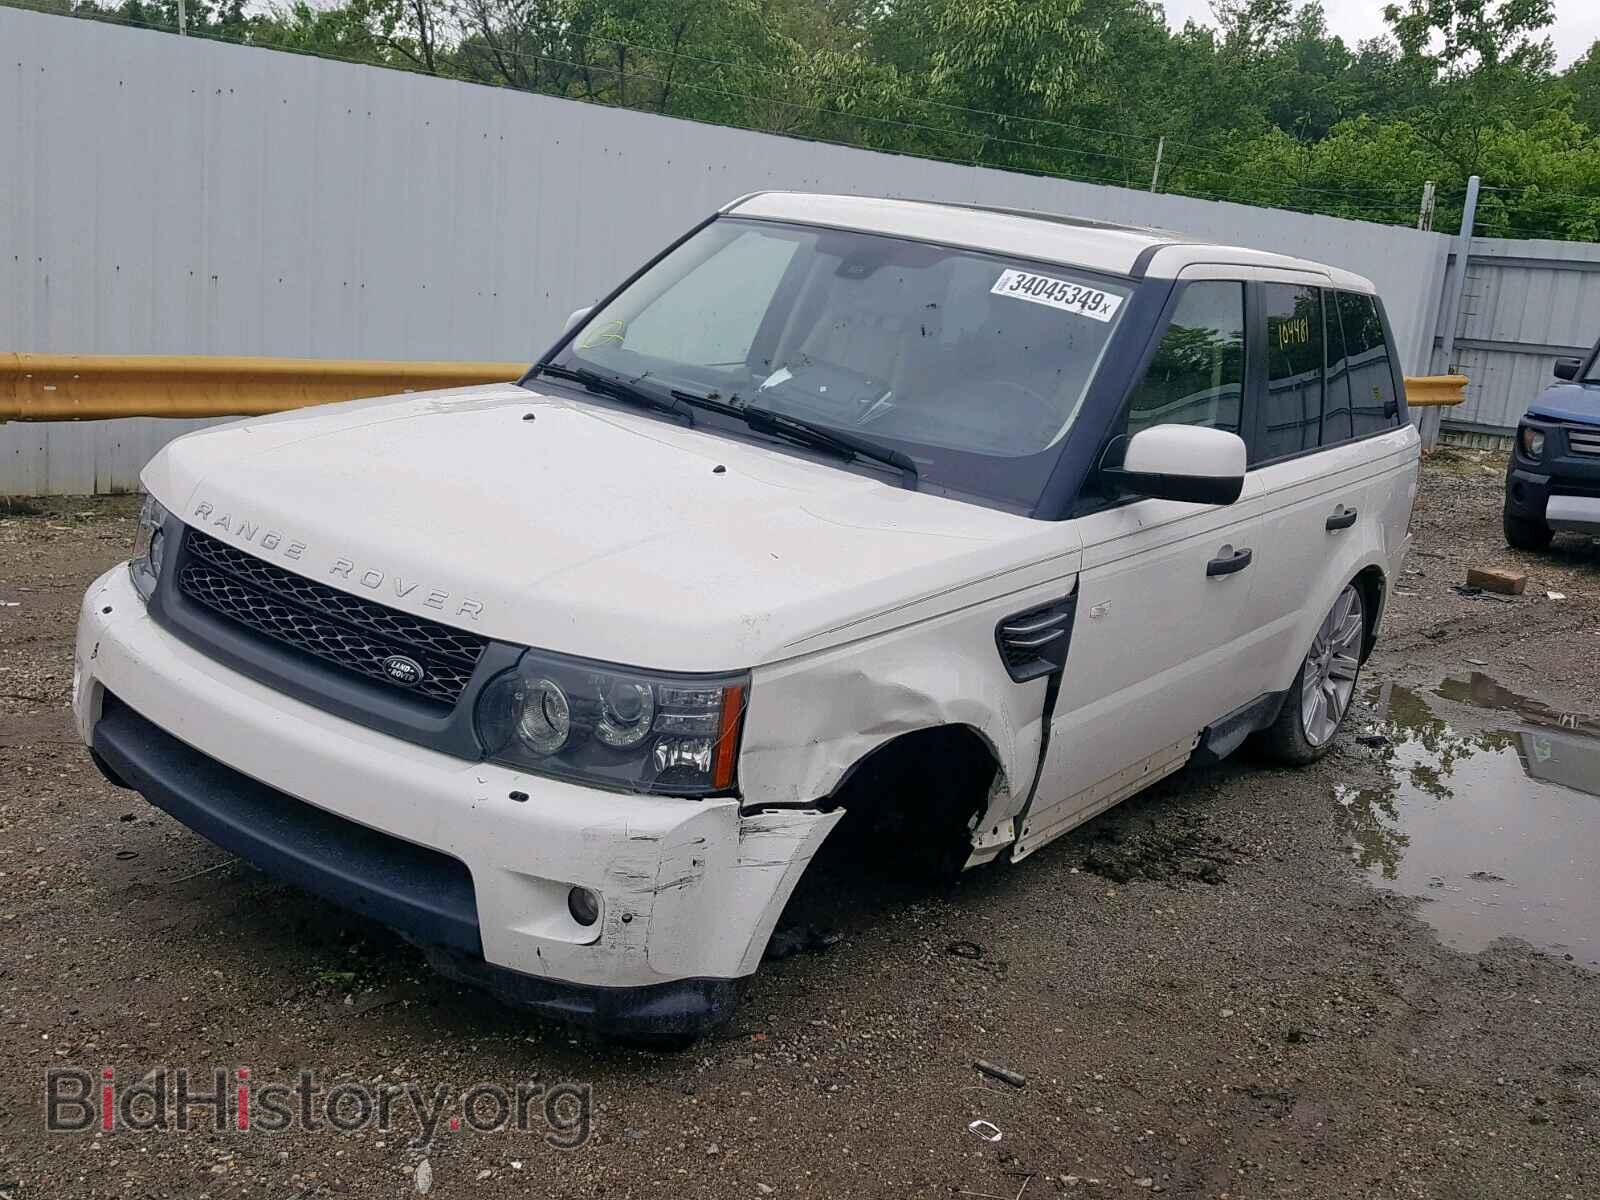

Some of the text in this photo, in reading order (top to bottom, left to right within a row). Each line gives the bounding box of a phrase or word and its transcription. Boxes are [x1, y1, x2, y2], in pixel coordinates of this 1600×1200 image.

[194, 501, 486, 621] RANGE ROVER
[390, 660, 411, 673] LAND
[390, 668, 416, 681] ROVER
